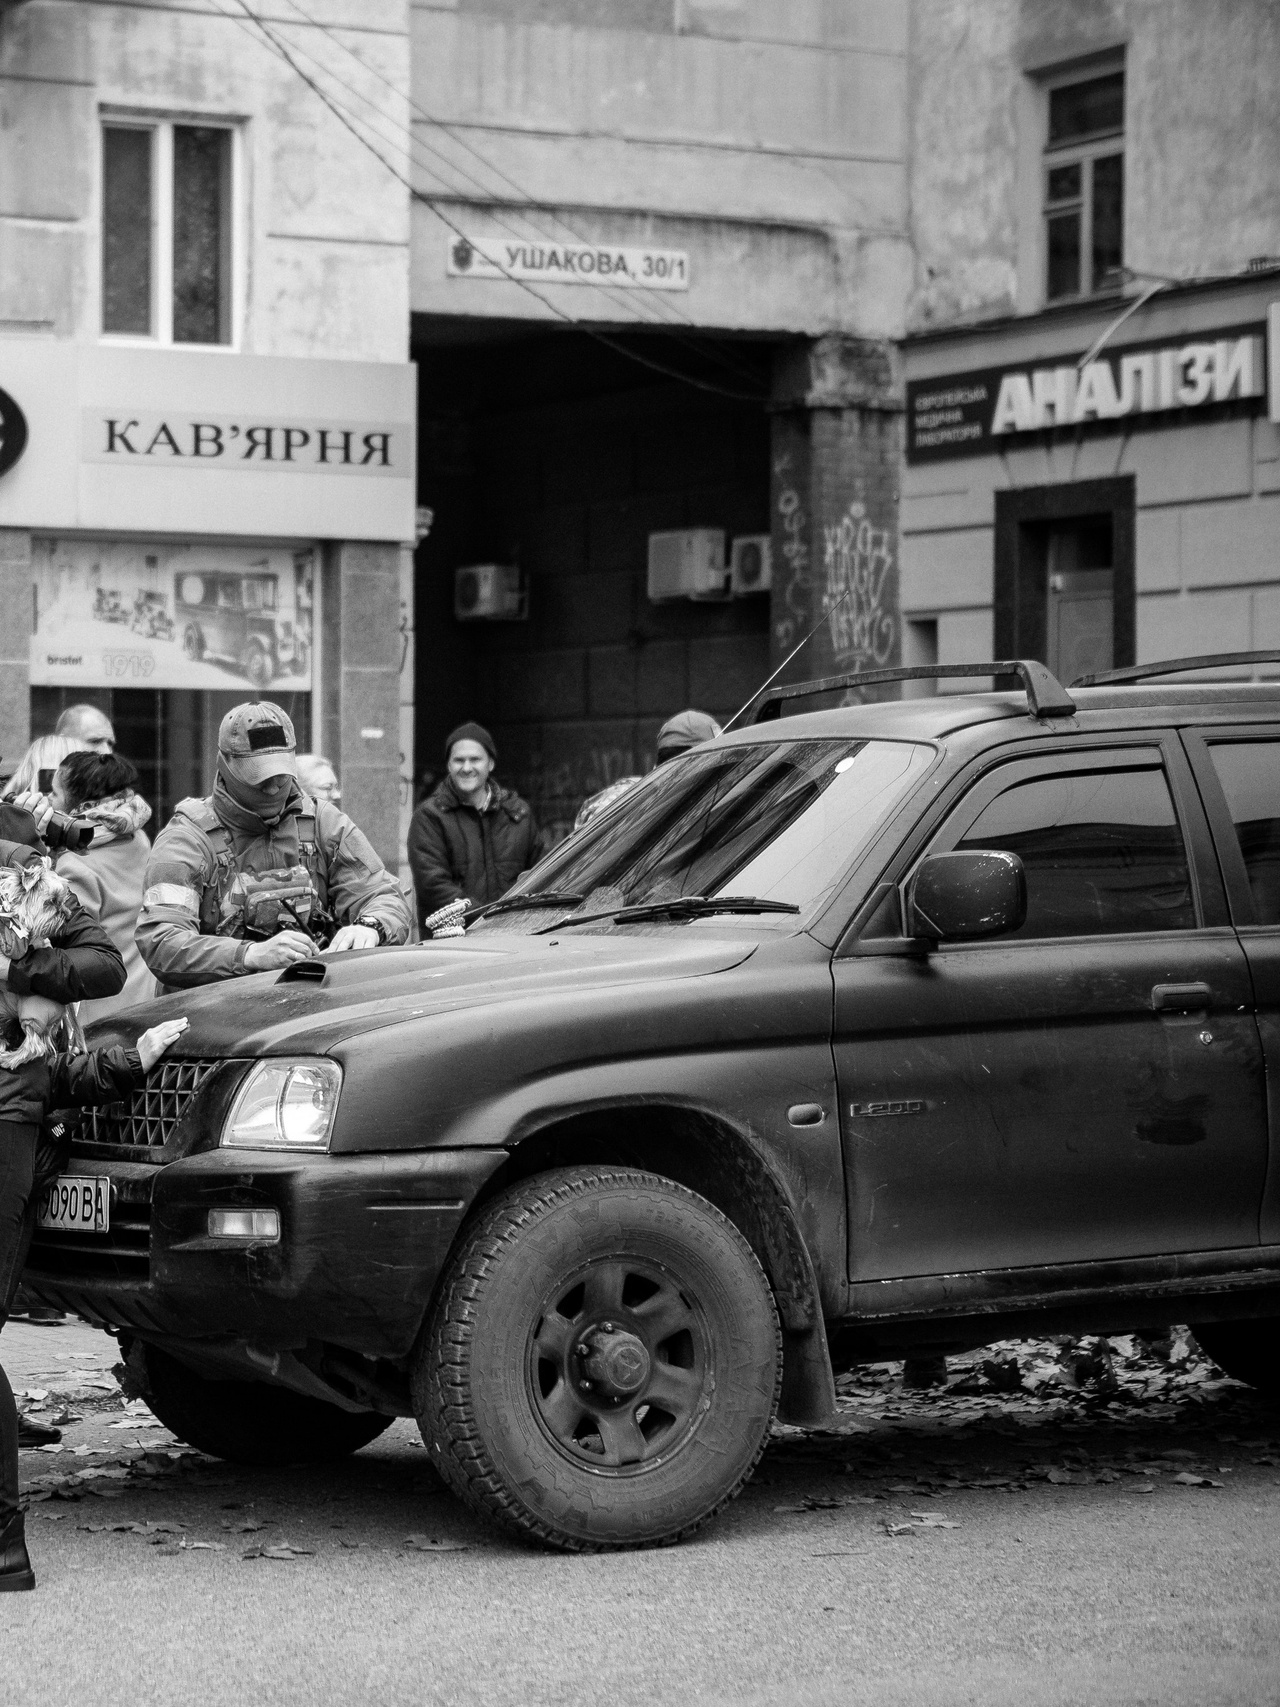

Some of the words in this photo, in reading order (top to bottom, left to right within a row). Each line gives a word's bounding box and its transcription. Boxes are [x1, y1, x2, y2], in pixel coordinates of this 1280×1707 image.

[505, 246, 636, 279] УШАКОВА,
[642, 255, 686, 280] 30/1
[990, 334, 1265, 436] АНАЛІЗИ
[102, 418, 394, 467] КАВ’ЯРНЯ
[101, 653, 156, 678] 1919
[850, 1100, 925, 1117] L200
